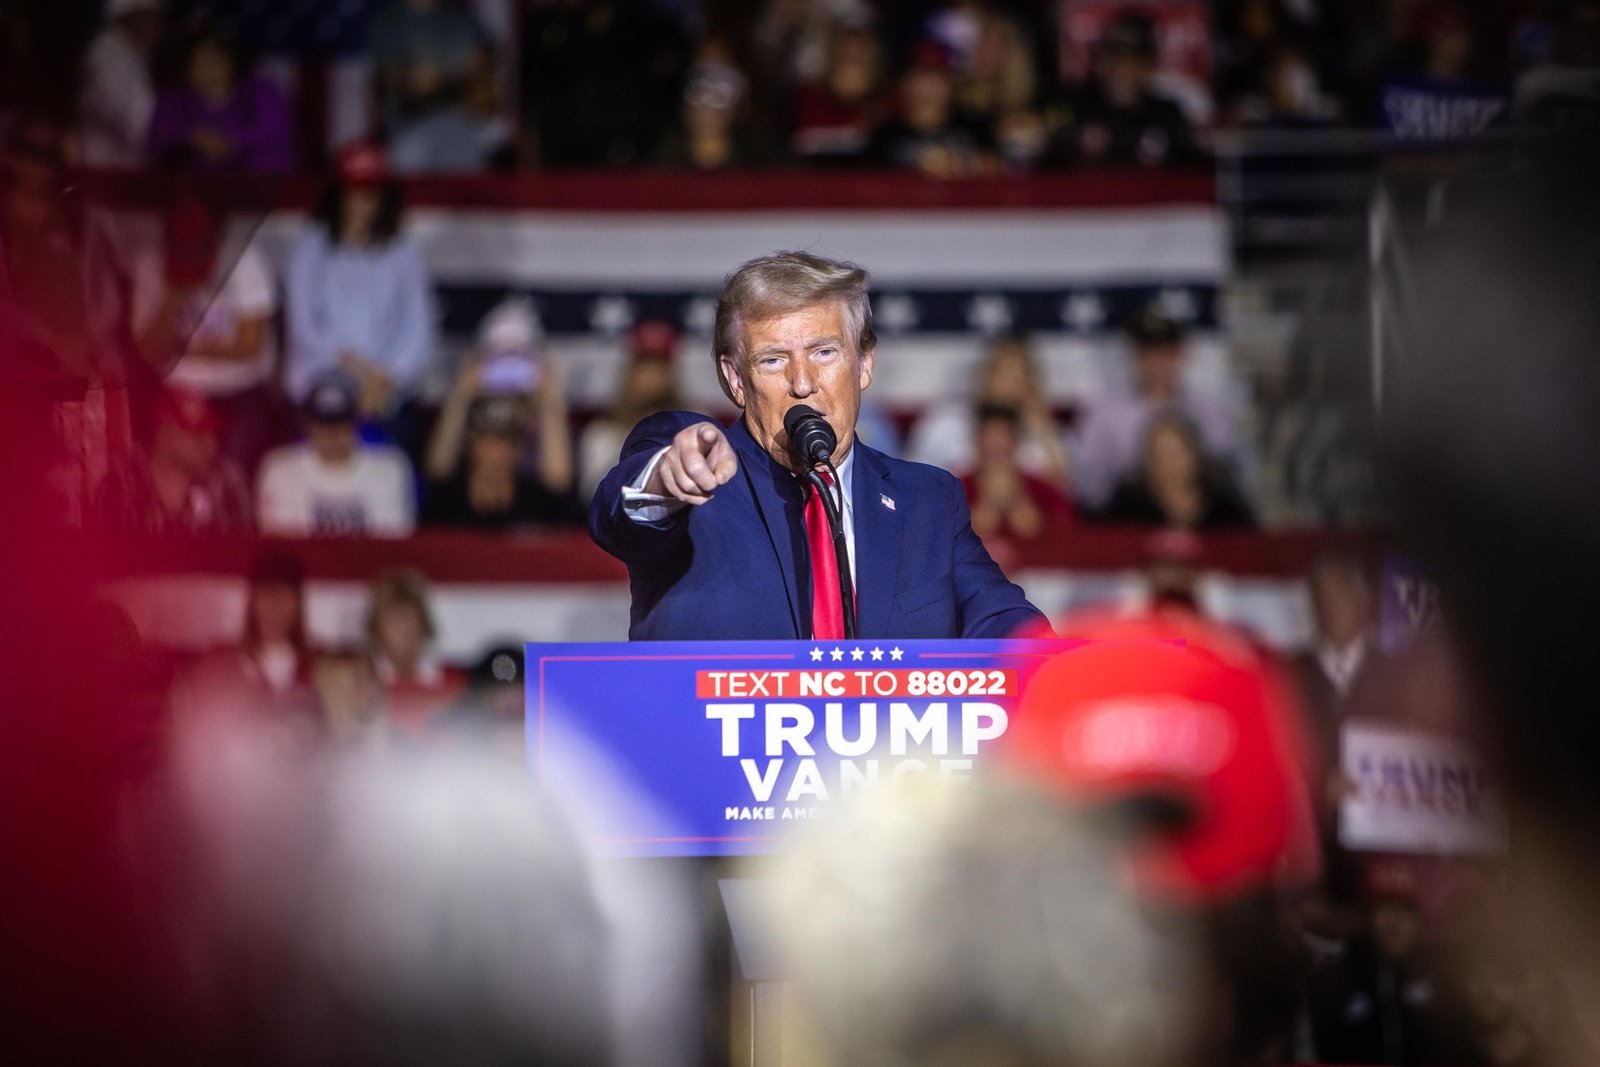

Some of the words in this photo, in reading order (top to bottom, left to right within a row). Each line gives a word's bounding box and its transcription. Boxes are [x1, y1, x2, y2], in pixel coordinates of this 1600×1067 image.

[708, 672, 790, 697] TEXT
[800, 672, 846, 696] NC
[855, 671, 898, 696] TO
[907, 670, 1006, 695] 88022
[706, 703, 1008, 756] TRUMP
[725, 806, 775, 820] MAKE
